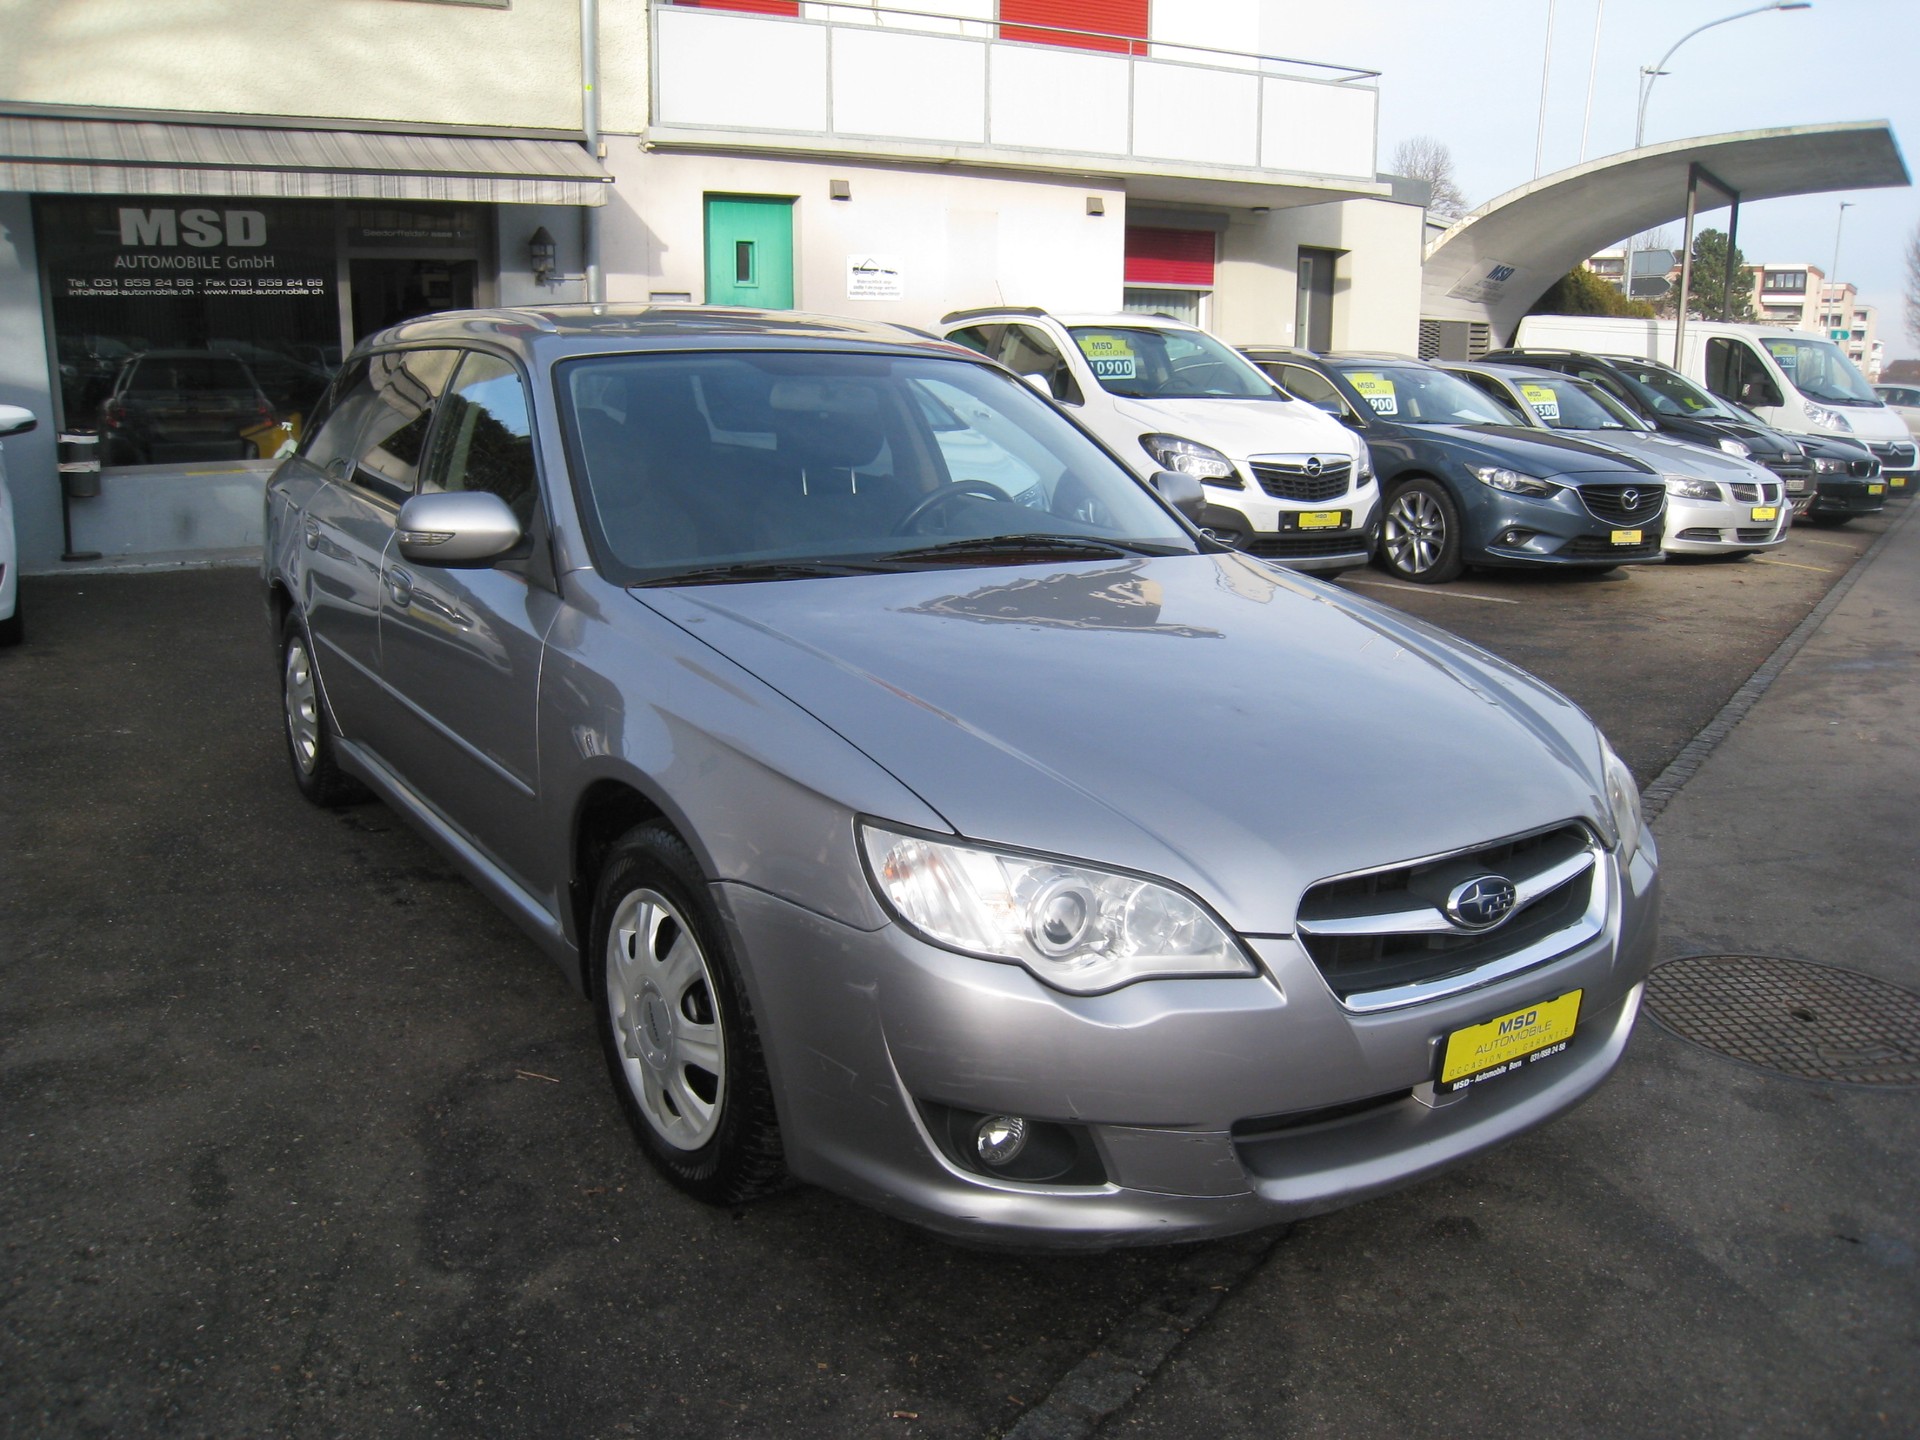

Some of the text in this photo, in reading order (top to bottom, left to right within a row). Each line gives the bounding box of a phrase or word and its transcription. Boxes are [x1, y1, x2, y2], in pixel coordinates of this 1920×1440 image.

[119, 208, 267, 248] MSD
[114, 255, 275, 269] AUTOMOBILE GmbH
[68, 278, 89, 287] Tel.
[93, 278, 118, 287] 031
[124, 278, 151, 287] 859
[155, 278, 172, 287] 24
[176, 278, 194, 287] 88
[205, 278, 226, 287] Fax
[229, 278, 252, 287] 031
[258, 278, 283, 287] 859
[286, 278, 303, 287] 24
[306, 278, 323, 287] 89
[68, 288, 194, 296] info@msd-automobile.ch
[1091, 342, 1113, 350] MSD
[1090, 360, 1132, 375] 0900
[1357, 381, 1376, 389] MSD
[1366, 398, 1393, 411] 900
[1499, 1011, 1537, 1035] MSD
[1475, 1021, 1551, 1055] AUTOMOBILE
[1450, 1053, 1501, 1076] OCCASION
[1523, 1029, 1568, 1050] GARANTIE
